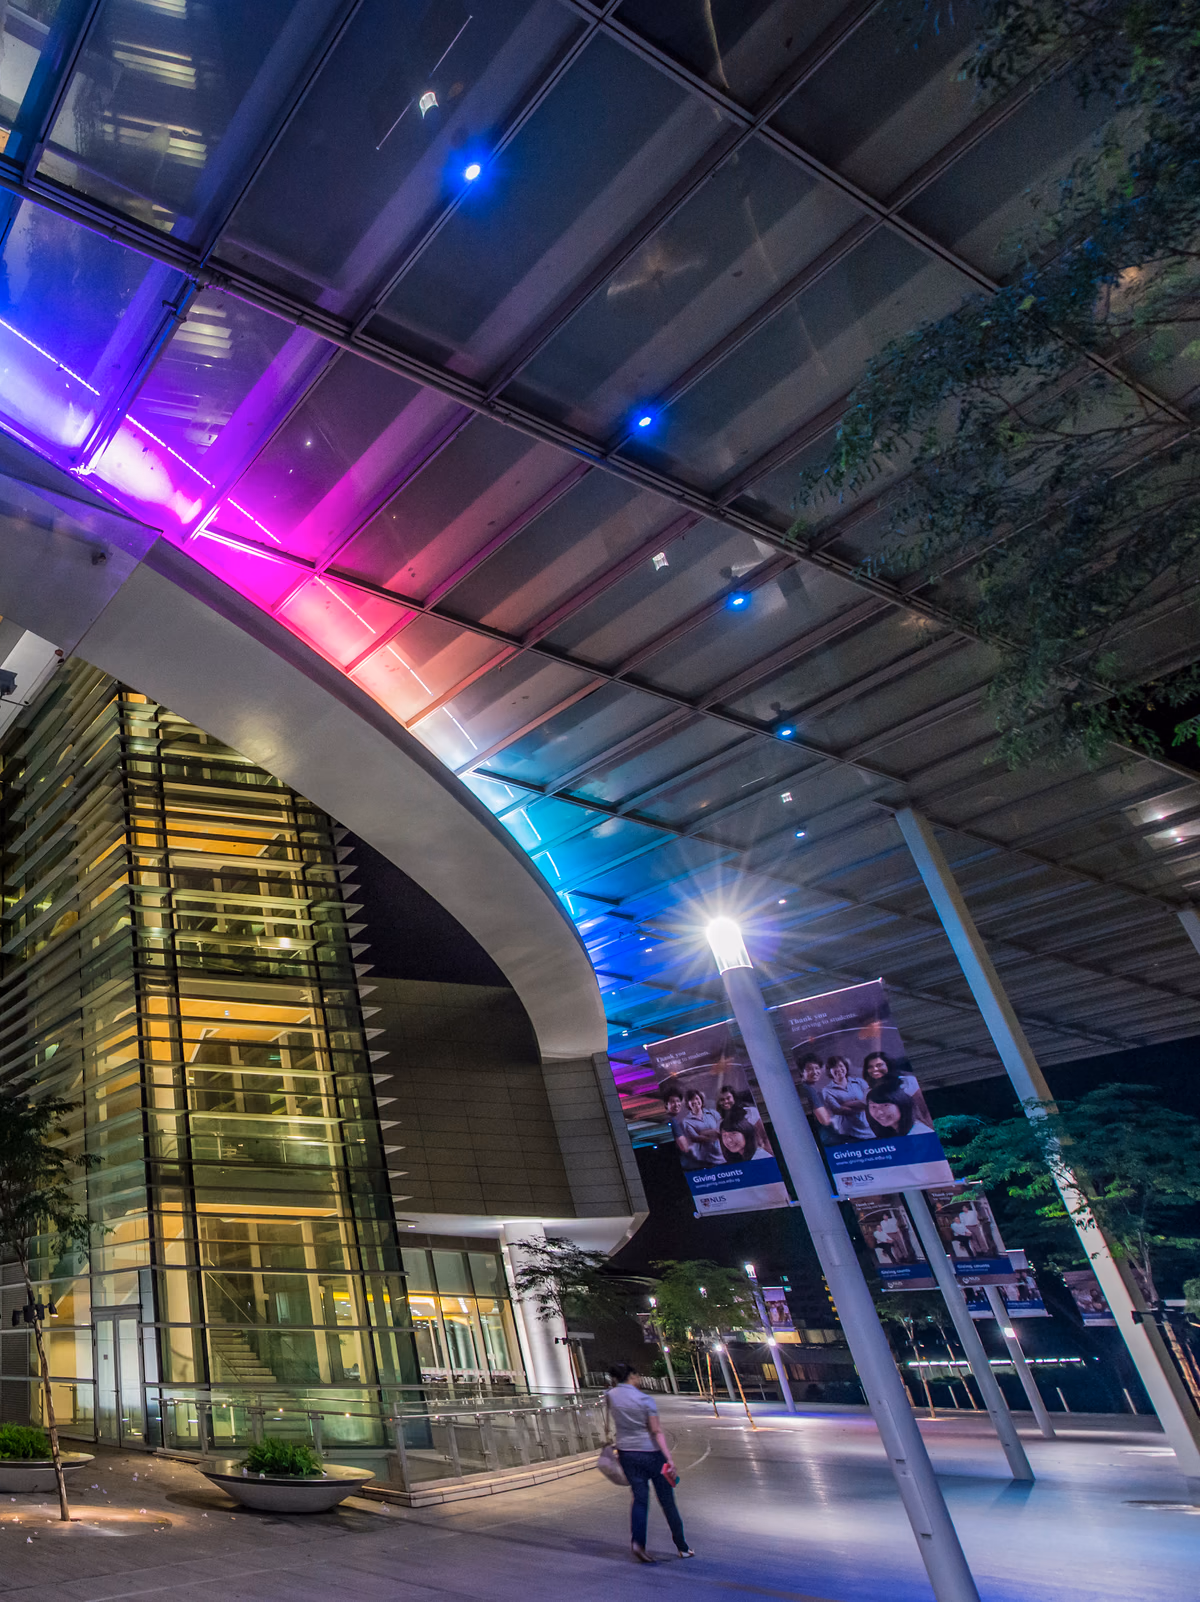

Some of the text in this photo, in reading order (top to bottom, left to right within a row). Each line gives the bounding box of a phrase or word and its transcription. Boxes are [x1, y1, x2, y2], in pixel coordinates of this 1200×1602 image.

[790, 1012, 827, 1025] Thank you
[833, 1145, 896, 1160] Giving counts
[693, 1169, 743, 1183] Giving counts
[853, 1174, 875, 1182] NUS
[710, 1195, 727, 1203] NUS
